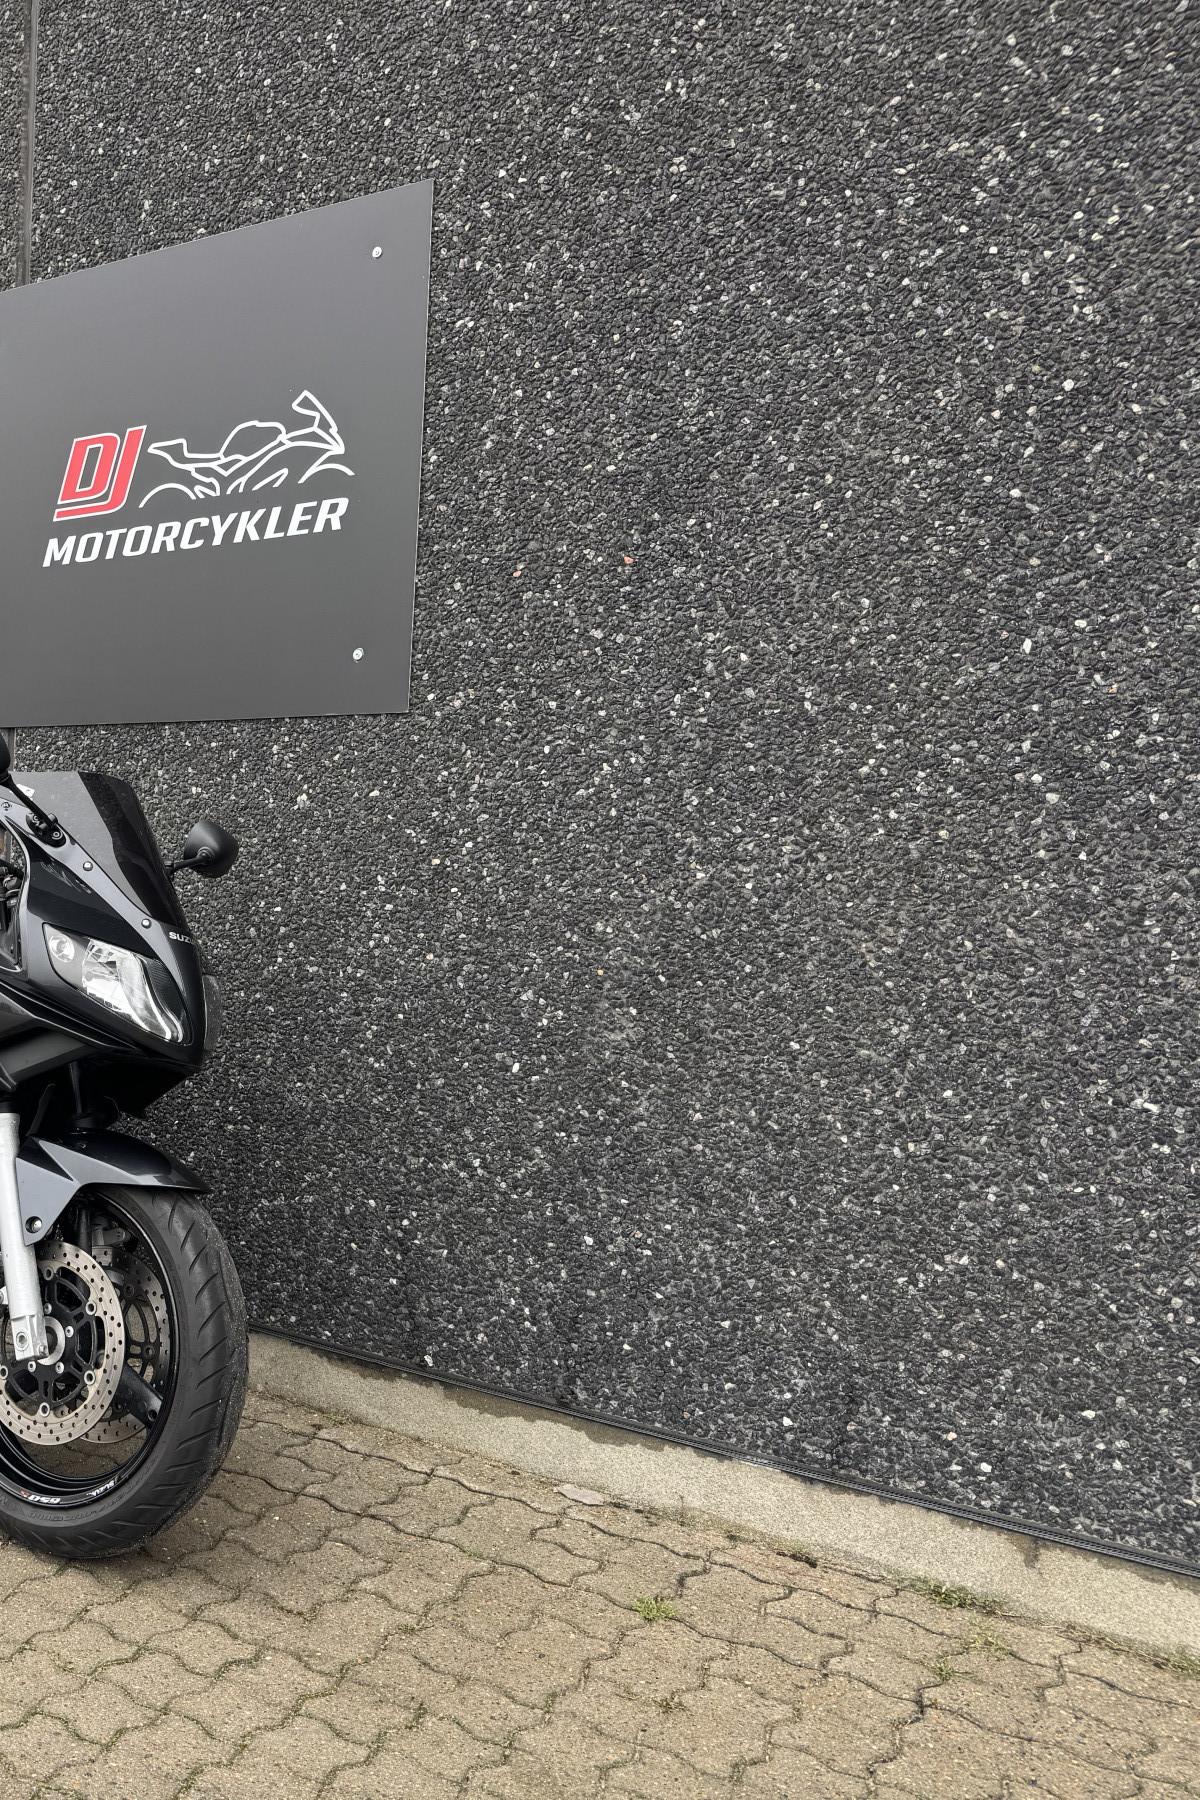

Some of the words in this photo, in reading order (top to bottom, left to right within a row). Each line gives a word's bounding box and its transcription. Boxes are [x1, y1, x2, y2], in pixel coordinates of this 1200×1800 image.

[53, 425, 147, 522] DJ
[43, 497, 350, 568] MOTORCYKLER
[168, 931, 194, 945] SUZ
